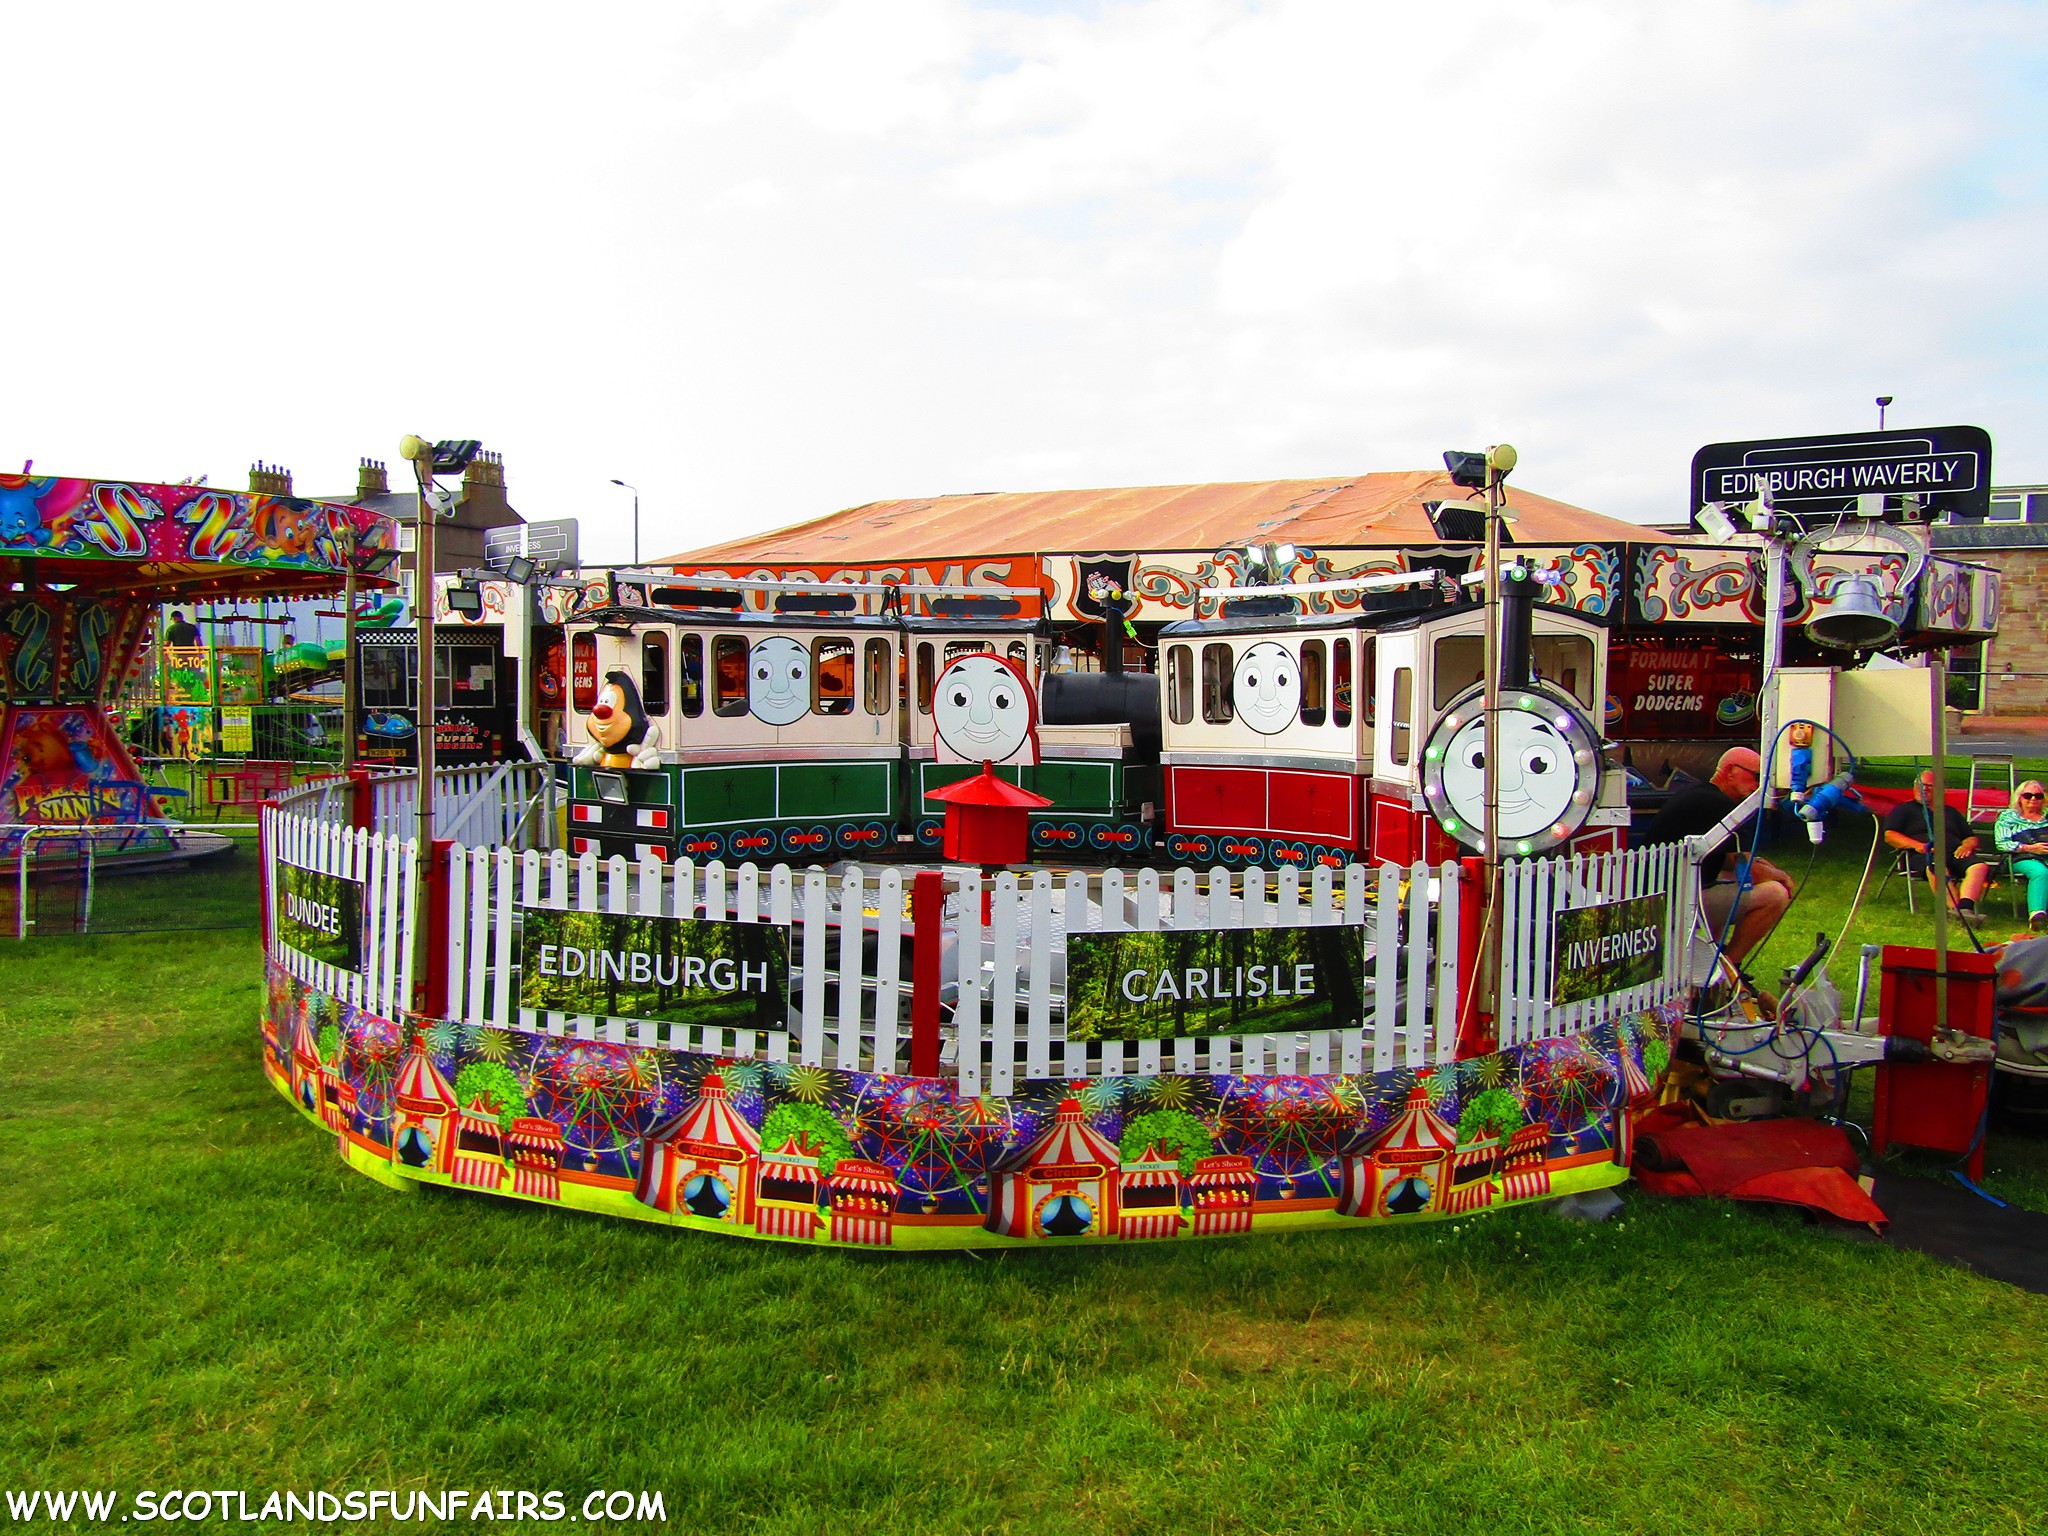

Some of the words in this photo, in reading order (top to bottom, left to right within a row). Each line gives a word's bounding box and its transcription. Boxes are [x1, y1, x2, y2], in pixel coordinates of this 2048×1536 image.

[1852, 460, 1959, 487] WAVERLY
[505, 540, 541, 554] INVEESS
[169, 656, 206, 669] TIC-TOC
[1629, 651, 1698, 669] FORMULA
[1703, 652, 1711, 668] 1
[1647, 673, 1694, 691] SUPER
[1633, 694, 1704, 711] DODGEMS
[287, 891, 340, 935] DUNDEE
[1567, 924, 1657, 971] INVERNESS
[539, 944, 768, 993] EDINBURGH
[1121, 963, 1315, 1002] CARLISLE
[689, 1144, 732, 1159] Circus
[843, 1163, 861, 1172] Let's
[863, 1166, 885, 1176] Shoot
[1203, 1160, 1219, 1169] Let's
[1221, 1160, 1243, 1168] Shoot
